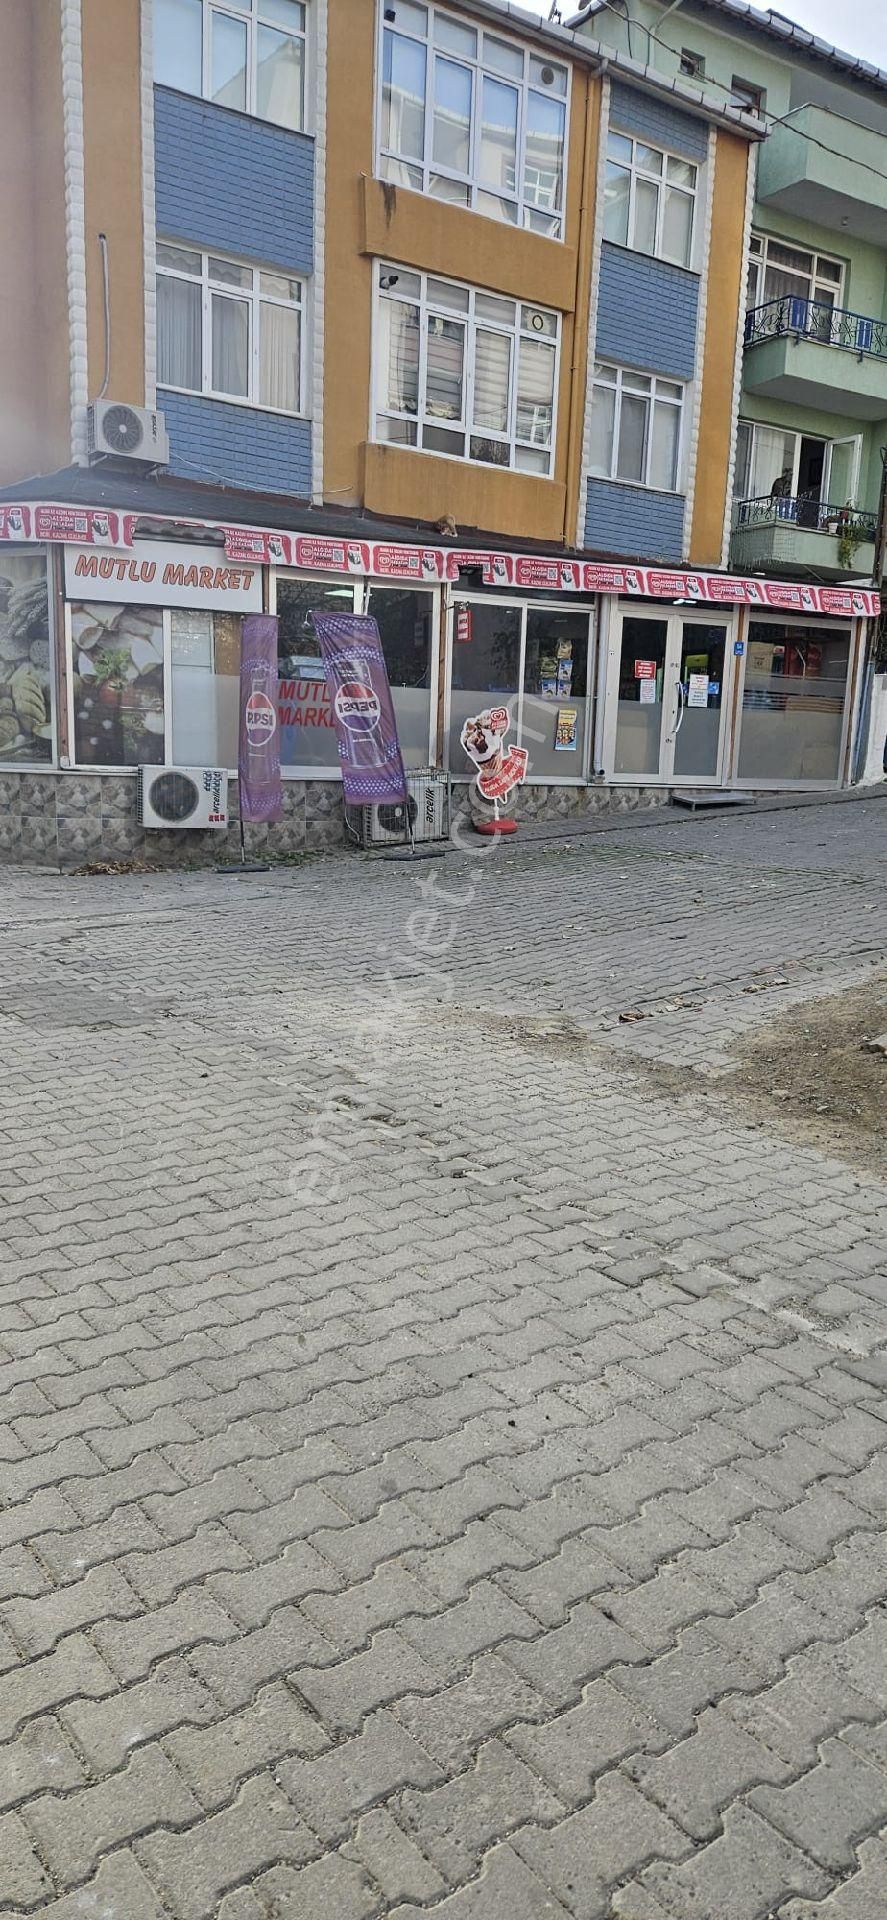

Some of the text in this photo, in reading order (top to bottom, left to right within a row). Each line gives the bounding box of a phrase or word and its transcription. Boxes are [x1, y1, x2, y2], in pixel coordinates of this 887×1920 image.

[74, 554, 255, 590] MUTLU MARKET
[278, 680, 331, 702] MUTL
